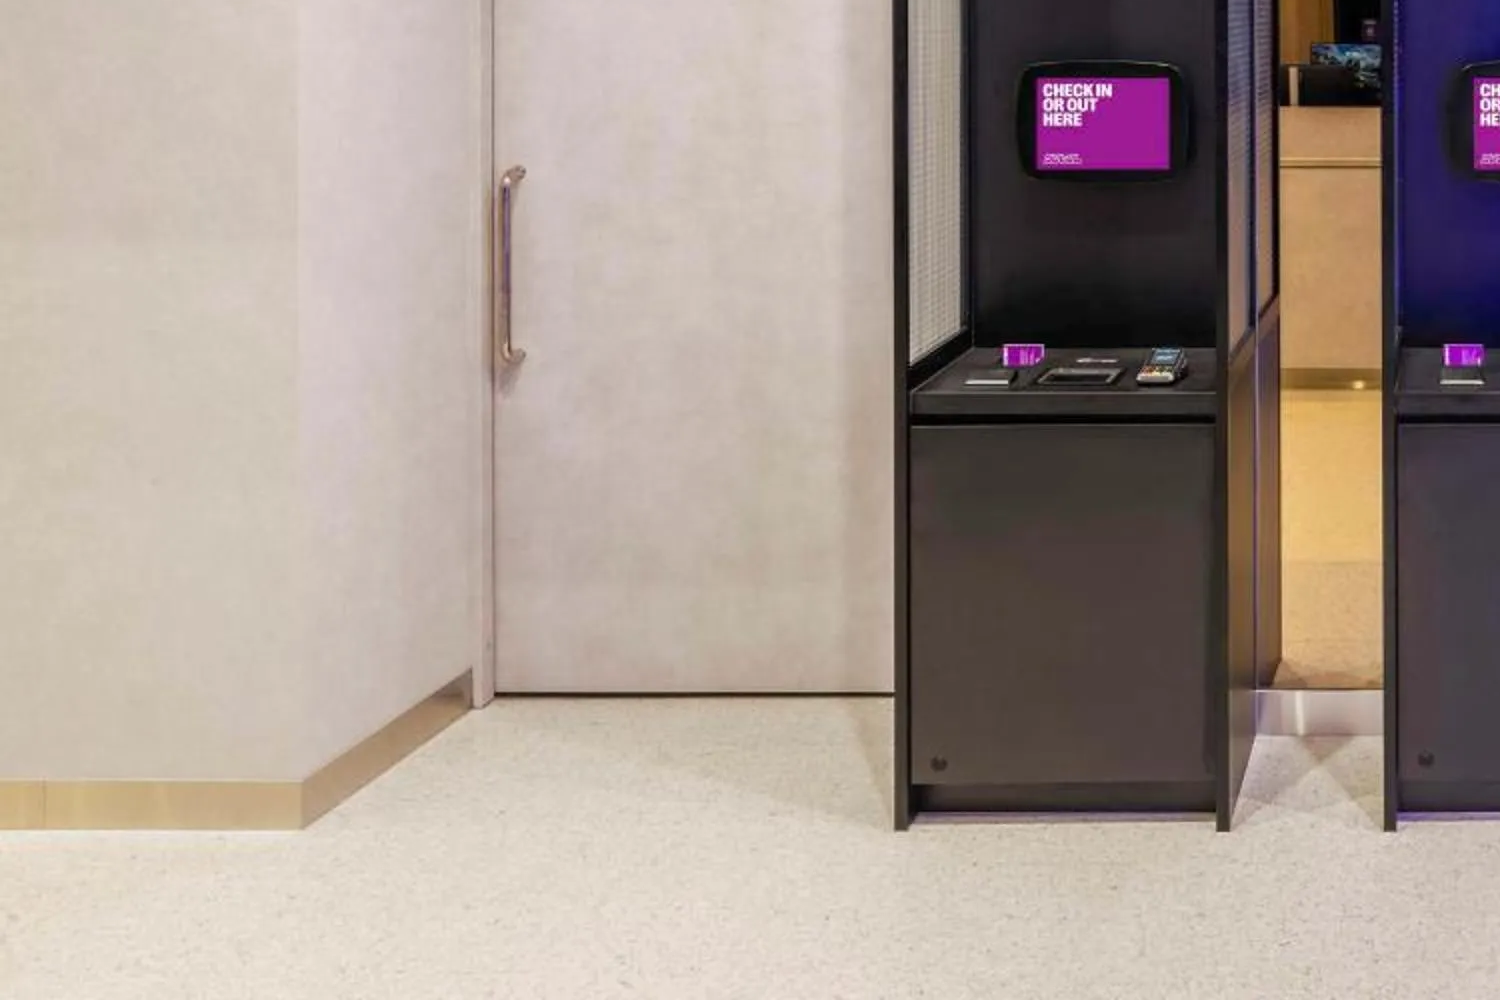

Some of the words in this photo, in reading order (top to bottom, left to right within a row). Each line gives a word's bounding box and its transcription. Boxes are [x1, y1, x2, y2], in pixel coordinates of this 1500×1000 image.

[1043, 83, 1093, 97] CHECK
[1096, 83, 1113, 97] IN
[1043, 98, 1065, 112] OR
[1067, 98, 1098, 112] OUT
[1043, 113, 1083, 127] HERE
